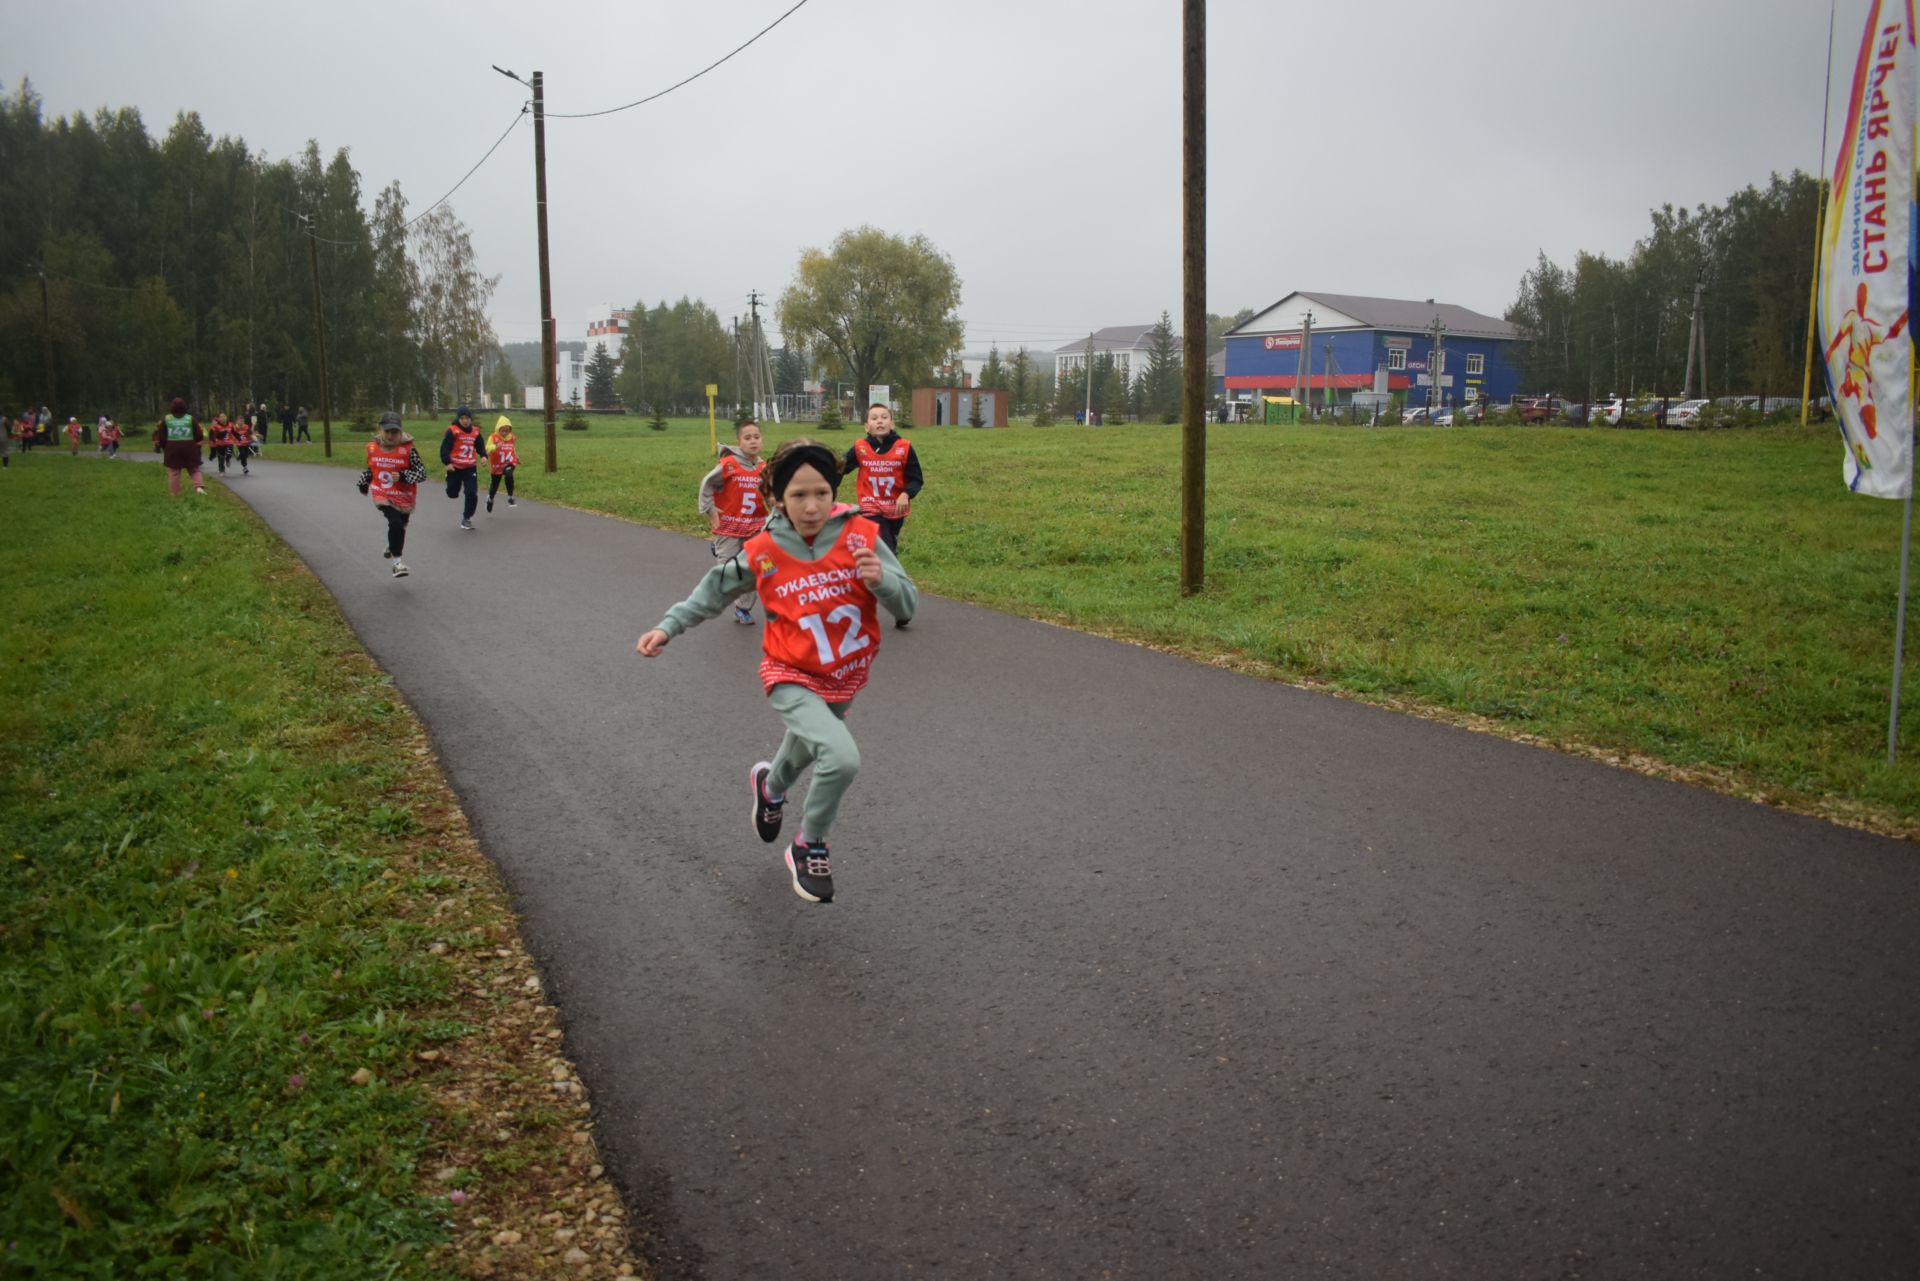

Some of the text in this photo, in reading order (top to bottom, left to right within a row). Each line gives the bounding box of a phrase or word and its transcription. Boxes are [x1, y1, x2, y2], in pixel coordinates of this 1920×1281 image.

[1863, 23, 1902, 274] СТАНЬ ЯРЧЕ!
[1851, 175, 1863, 277] ЗАЙМИСЬ
[459, 445, 474, 458] 21
[499, 451, 514, 463] 14
[378, 471, 394, 489] 9
[868, 476, 896, 497] 17
[740, 492, 757, 515] 5
[798, 583, 852, 606] РАЙОН
[798, 603, 871, 666] 12
